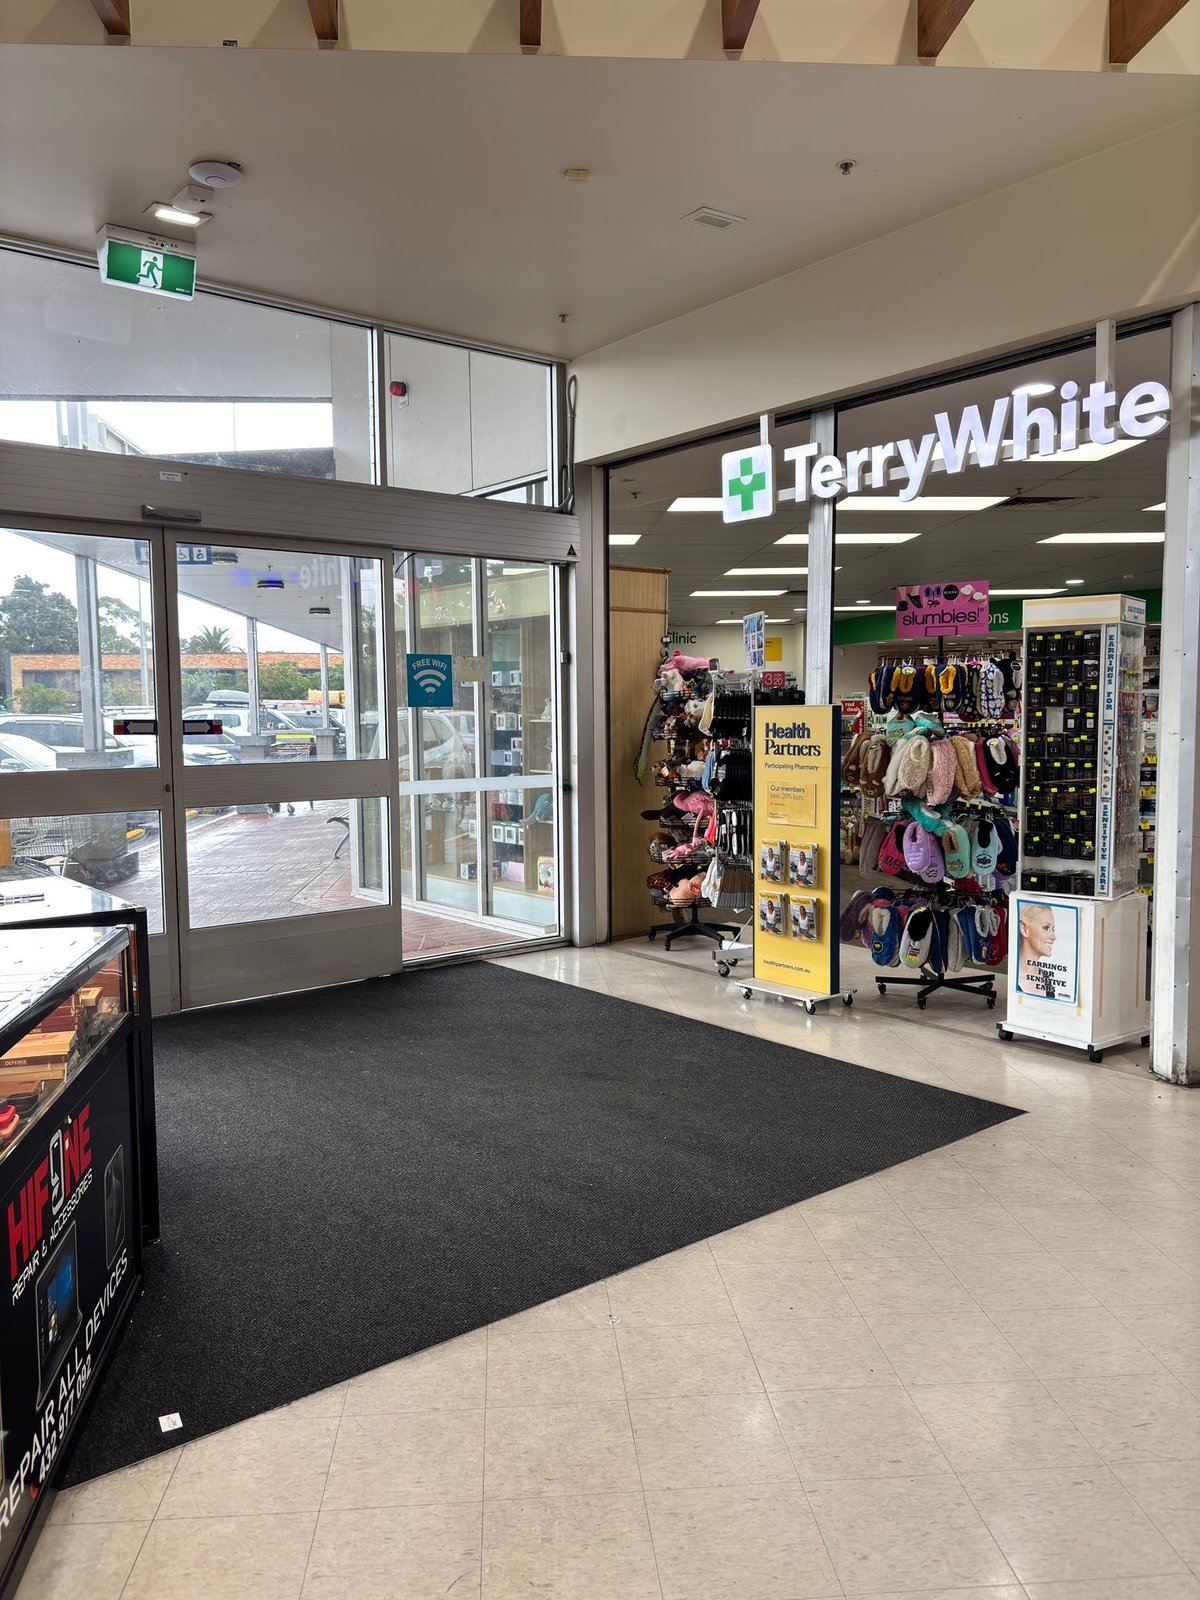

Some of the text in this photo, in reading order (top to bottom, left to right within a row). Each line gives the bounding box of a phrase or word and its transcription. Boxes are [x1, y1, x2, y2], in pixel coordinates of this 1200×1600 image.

[783, 381, 1172, 502] TerryWhite
[411, 658, 448, 671] FREE WIFI
[1106, 634, 1115, 686] EARRINGS
[764, 673, 773, 686] 3
[1105, 691, 1113, 711] FOR
[764, 722, 811, 739] Health
[764, 738, 822, 757] Partners
[764, 762, 819, 771] Participating Pharmacy
[770, 784, 781, 792] Our
[1100, 804, 1109, 860] SENSITIVE
[1099, 866, 1107, 891] EARS
[762, 958, 811, 974] healthpartners.com.au
[1026, 959, 1068, 972] EARRINGS
[1037, 967, 1055, 978] FOR
[1025, 974, 1067, 988] SENSITIVE
[1035, 983, 1056, 993] EARS
[11, 1249, 40, 1307] REPAIR
[49, 1167, 94, 1246] ACCESSORIES
[58, 1346, 83, 1413] ALL
[84, 1247, 128, 1351] DEVICES
[76, 1353, 92, 1400] 092
